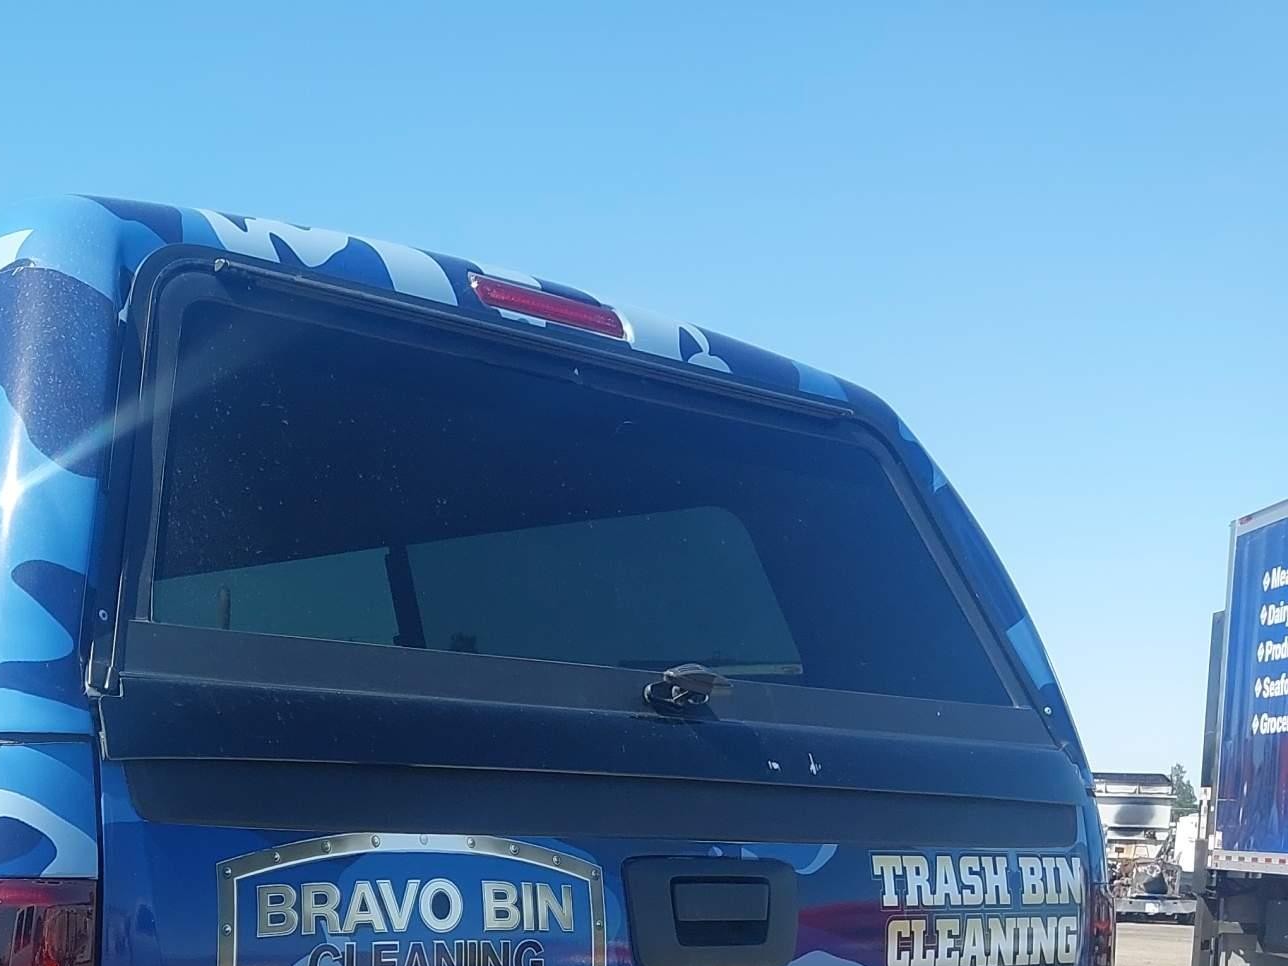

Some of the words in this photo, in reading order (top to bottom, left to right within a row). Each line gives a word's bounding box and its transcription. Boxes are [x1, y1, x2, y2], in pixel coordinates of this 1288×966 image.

[256, 879, 462, 938] BRAVO
[482, 880, 575, 933] BIN
[871, 855, 1012, 907] TRASH
[1019, 857, 1083, 905] BIN
